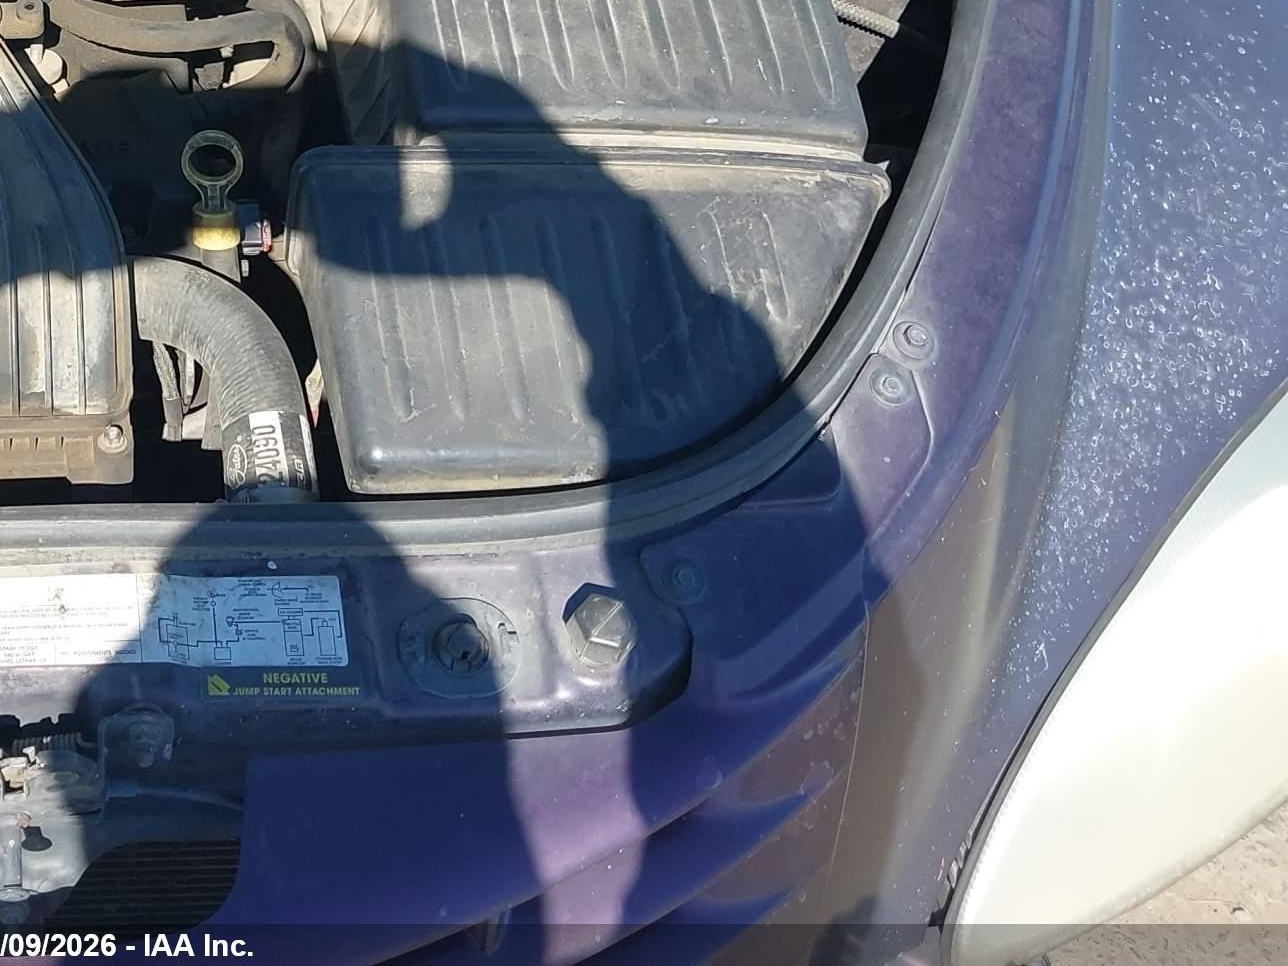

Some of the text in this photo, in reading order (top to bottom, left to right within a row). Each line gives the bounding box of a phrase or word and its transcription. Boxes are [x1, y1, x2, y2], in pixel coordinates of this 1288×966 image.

[263, 673, 328, 684] NEGATIVE
[233, 687, 360, 696] JUMP START ATTACHMENT
